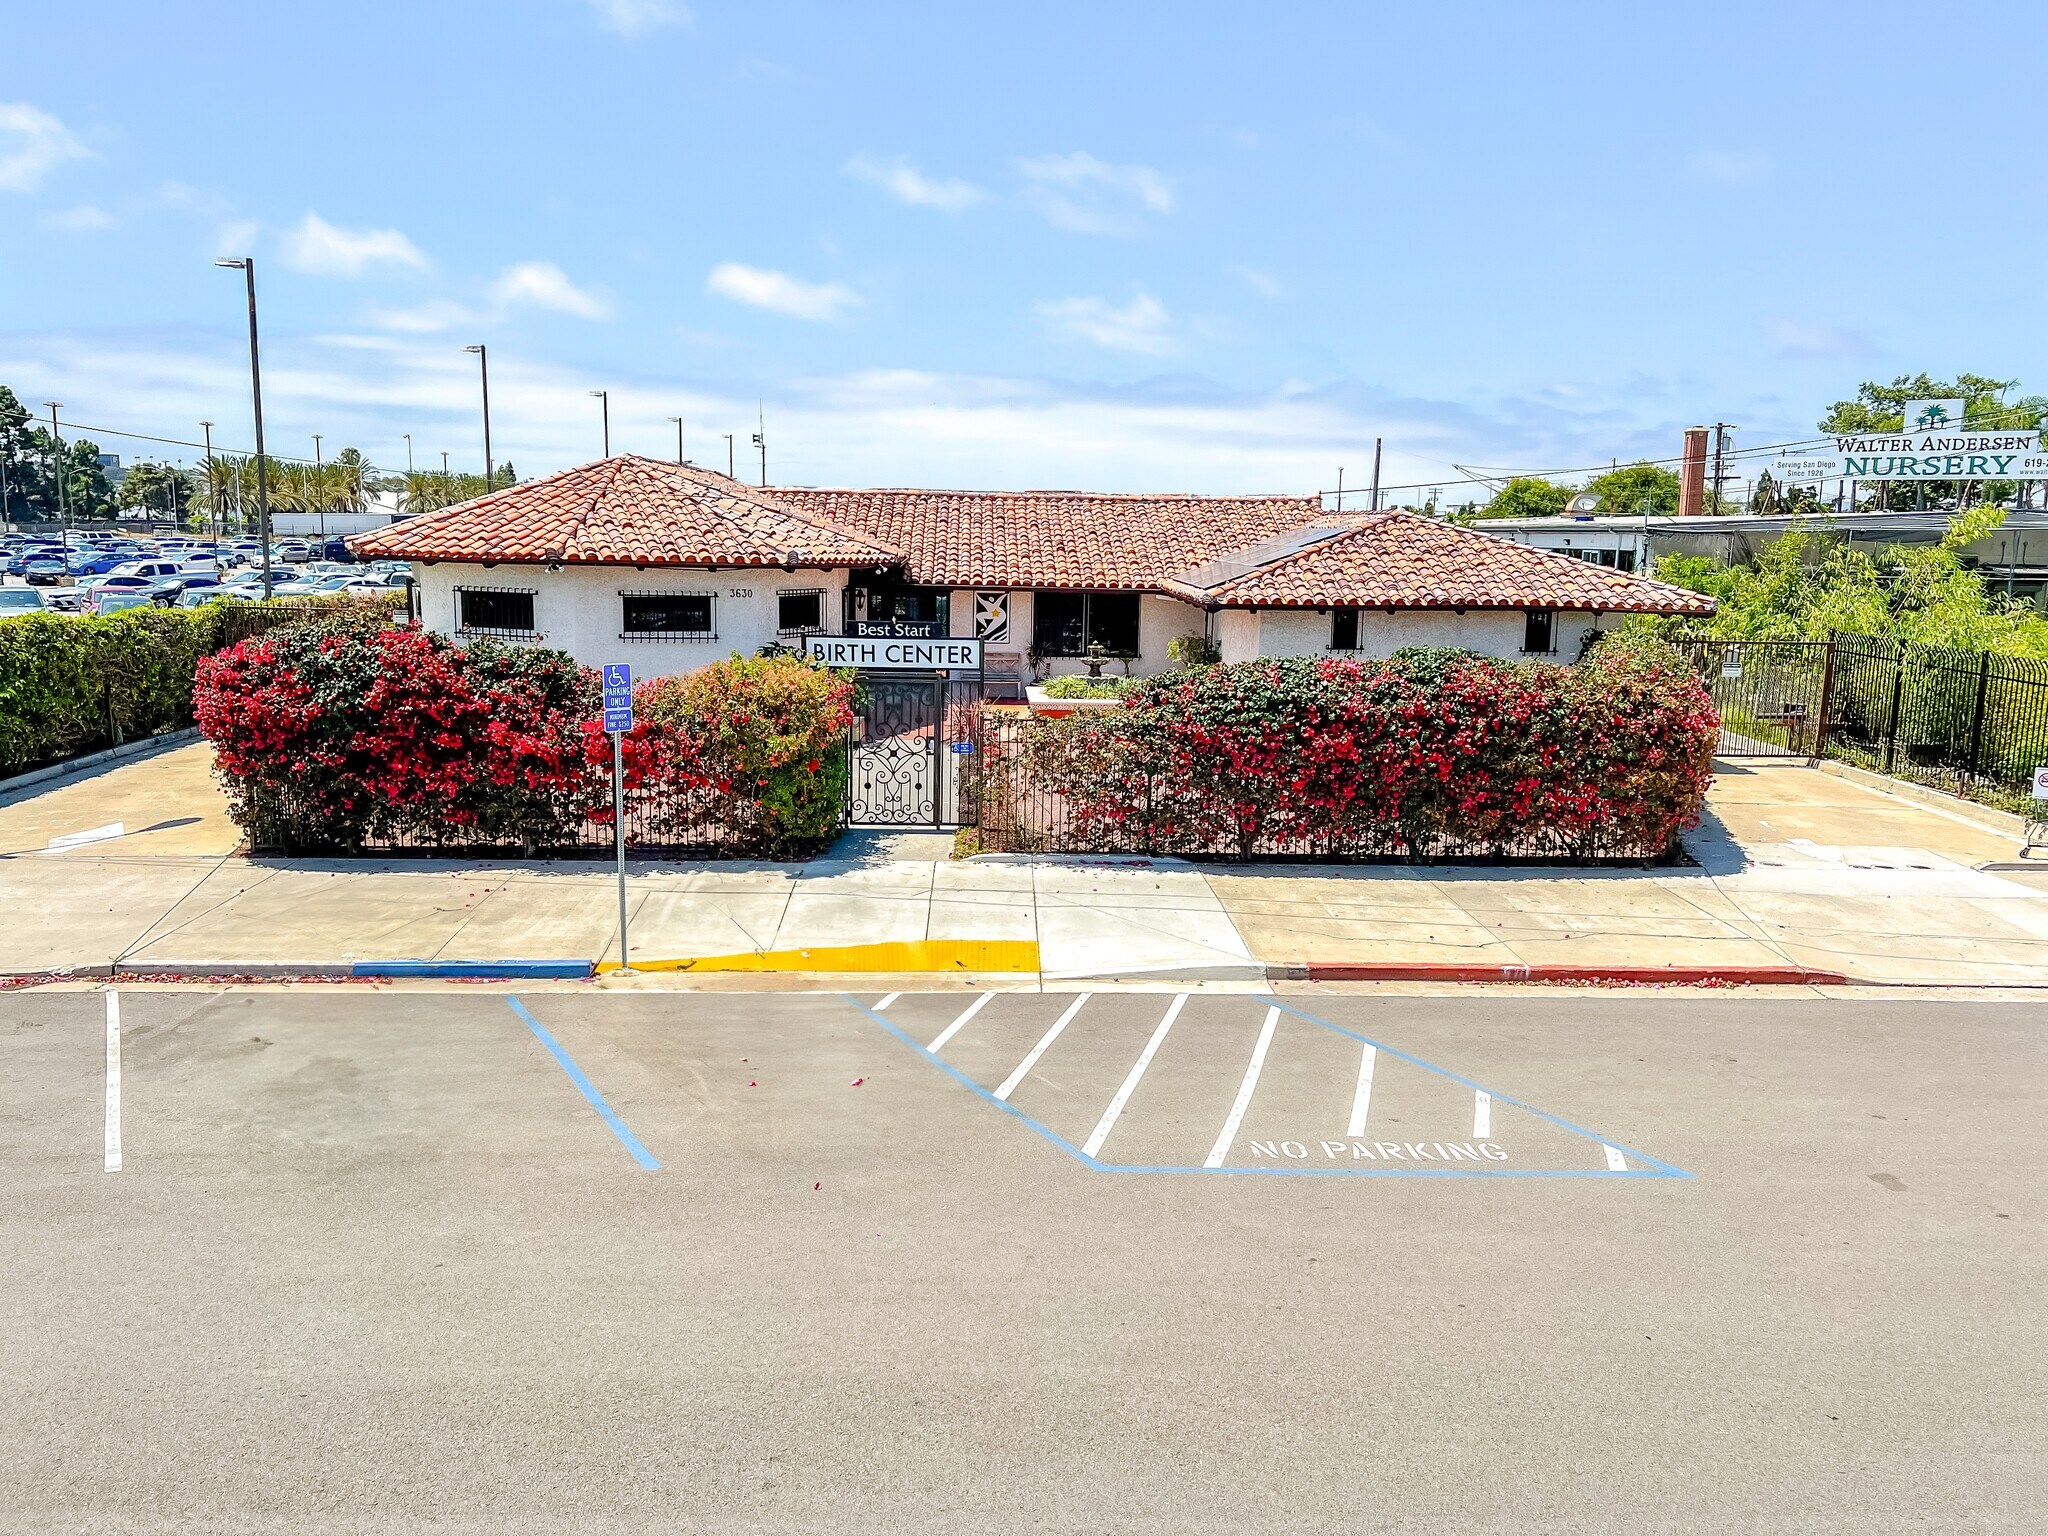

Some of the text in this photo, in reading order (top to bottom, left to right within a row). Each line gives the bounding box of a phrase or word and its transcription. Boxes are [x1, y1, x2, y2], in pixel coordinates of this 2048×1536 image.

[1836, 436, 2031, 453] WALTER ANDERSEN
[1817, 461, 1836, 469] Diego
[1843, 455, 2017, 476] NURSERY
[729, 589, 753, 598] 3630
[858, 623, 930, 637] Best Start
[813, 643, 973, 664] BIRTH CENTER
[605, 687, 630, 696] PARKING
[611, 697, 625, 706] ONLY
[1250, 1140, 1509, 1161] NO PARKING
